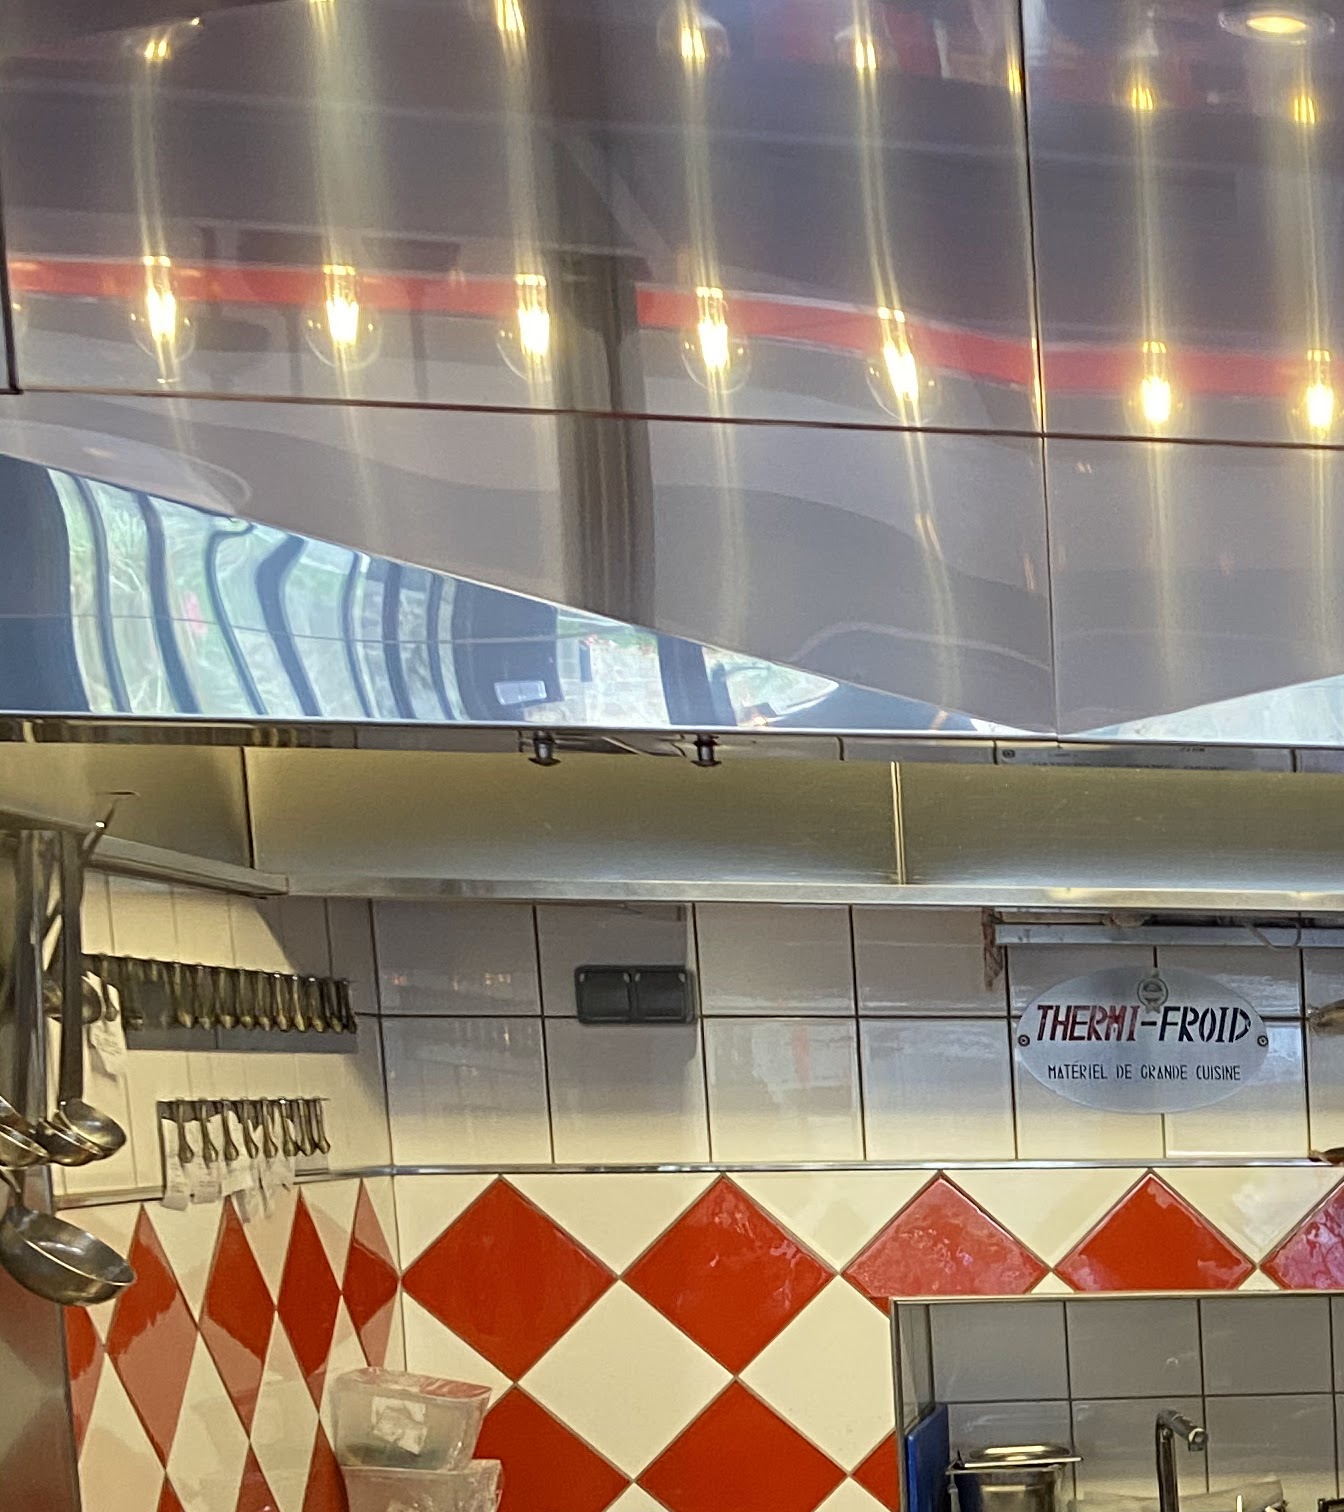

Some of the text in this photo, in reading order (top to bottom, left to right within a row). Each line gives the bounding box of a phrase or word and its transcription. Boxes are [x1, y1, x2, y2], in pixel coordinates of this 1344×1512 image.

[1036, 1003, 1252, 1043] THERMI-FROID
[1048, 1060, 1241, 1081] MATÉRIEL DE GRANDE CUISINE
